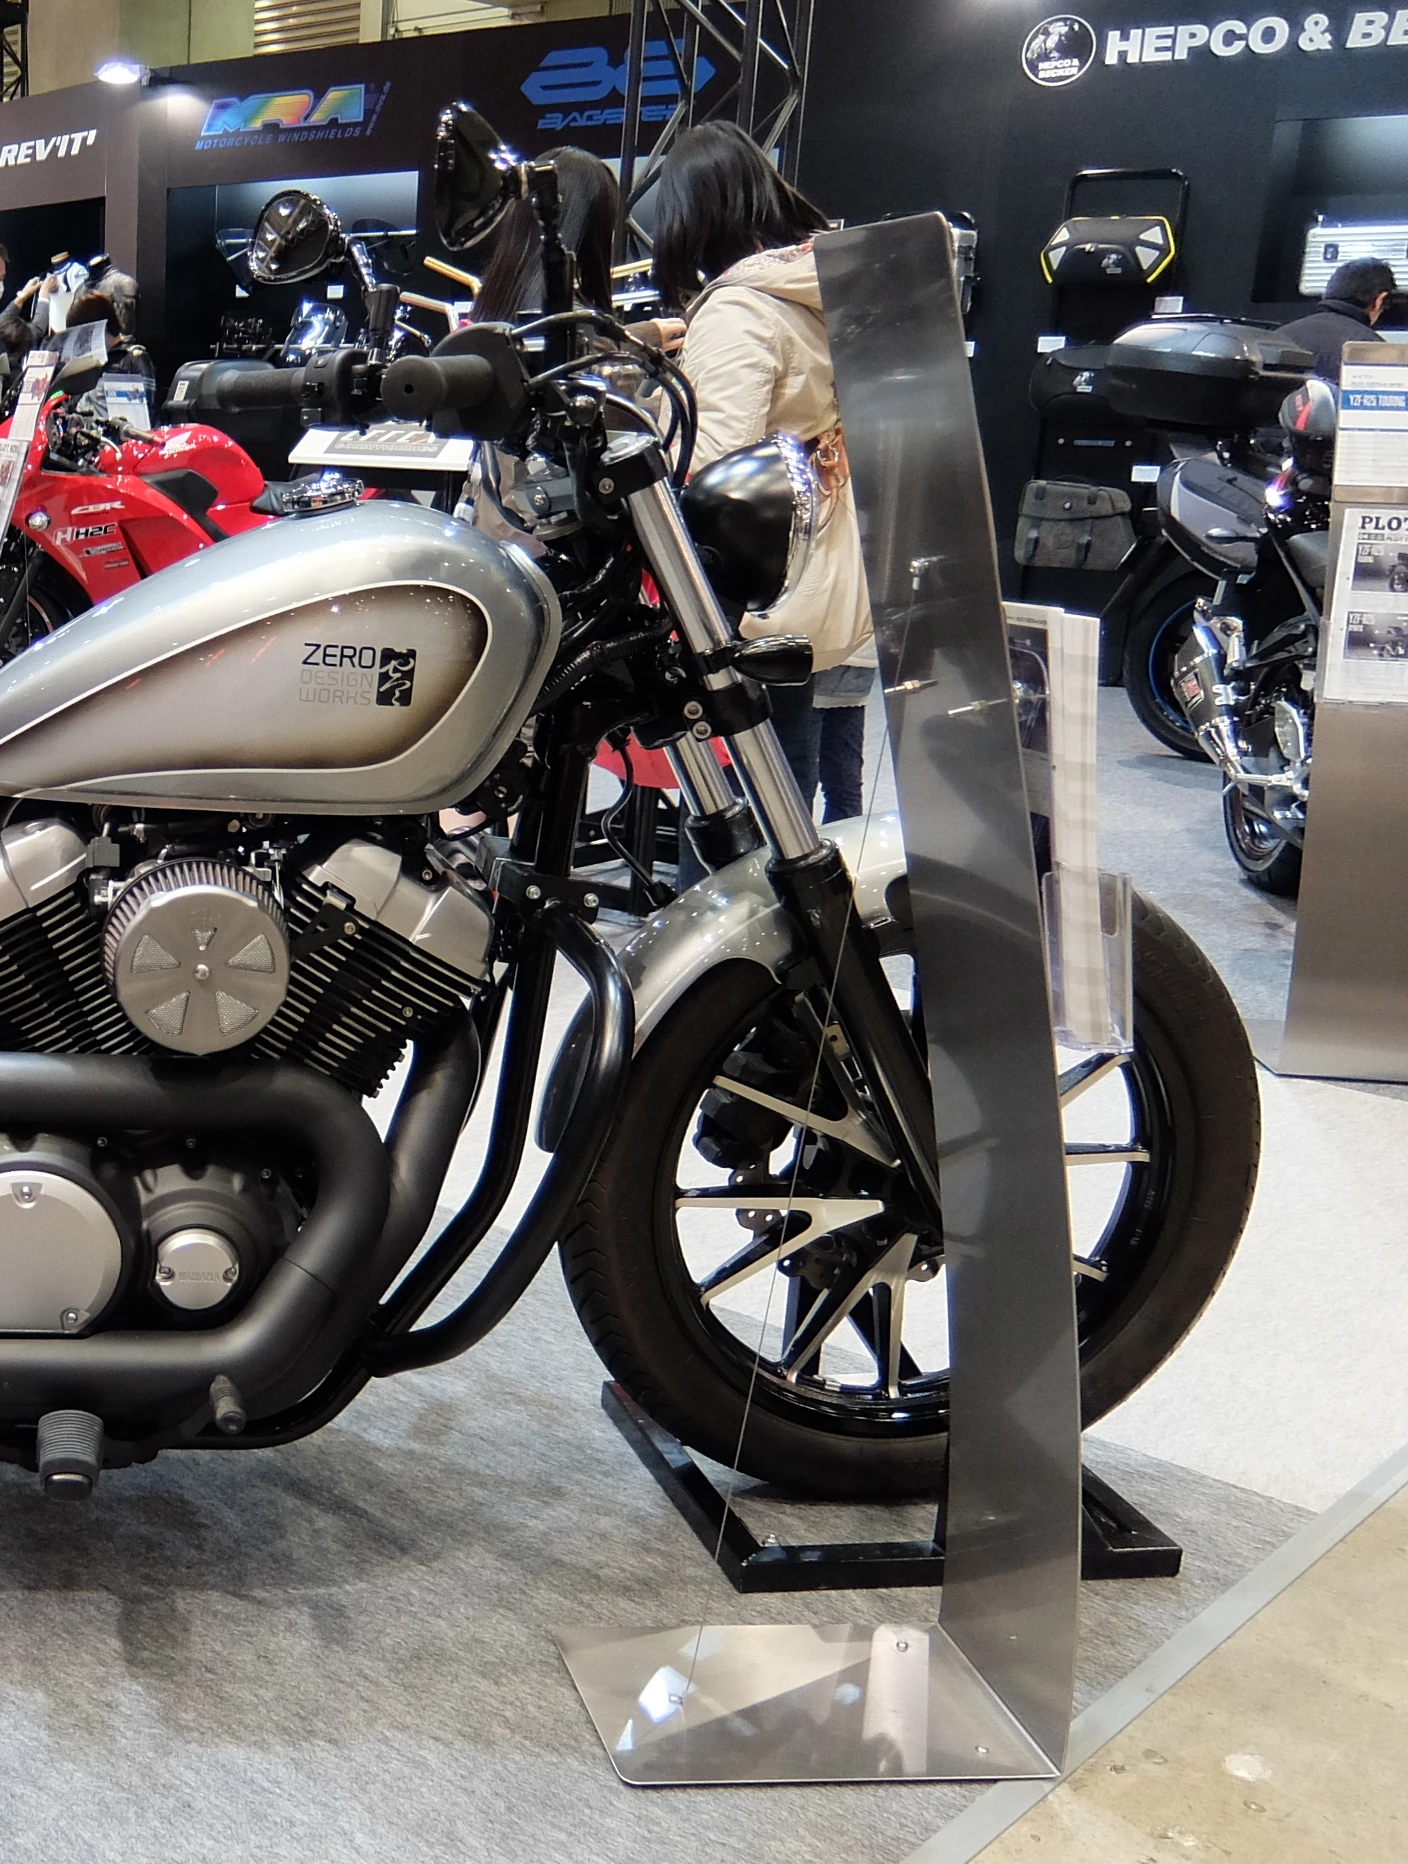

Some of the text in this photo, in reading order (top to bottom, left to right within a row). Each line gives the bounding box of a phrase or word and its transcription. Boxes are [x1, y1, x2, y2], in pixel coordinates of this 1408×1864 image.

[1105, 17, 1289, 65] HEPCO
[1298, 13, 1332, 51] &
[201, 83, 365, 136] MRA
[195, 127, 361, 150] MOTORCYCLE WINDSHIELDS
[302, 643, 376, 669] ZERO
[300, 669, 374, 688] DESIGN
[299, 687, 372, 706] WORKS
